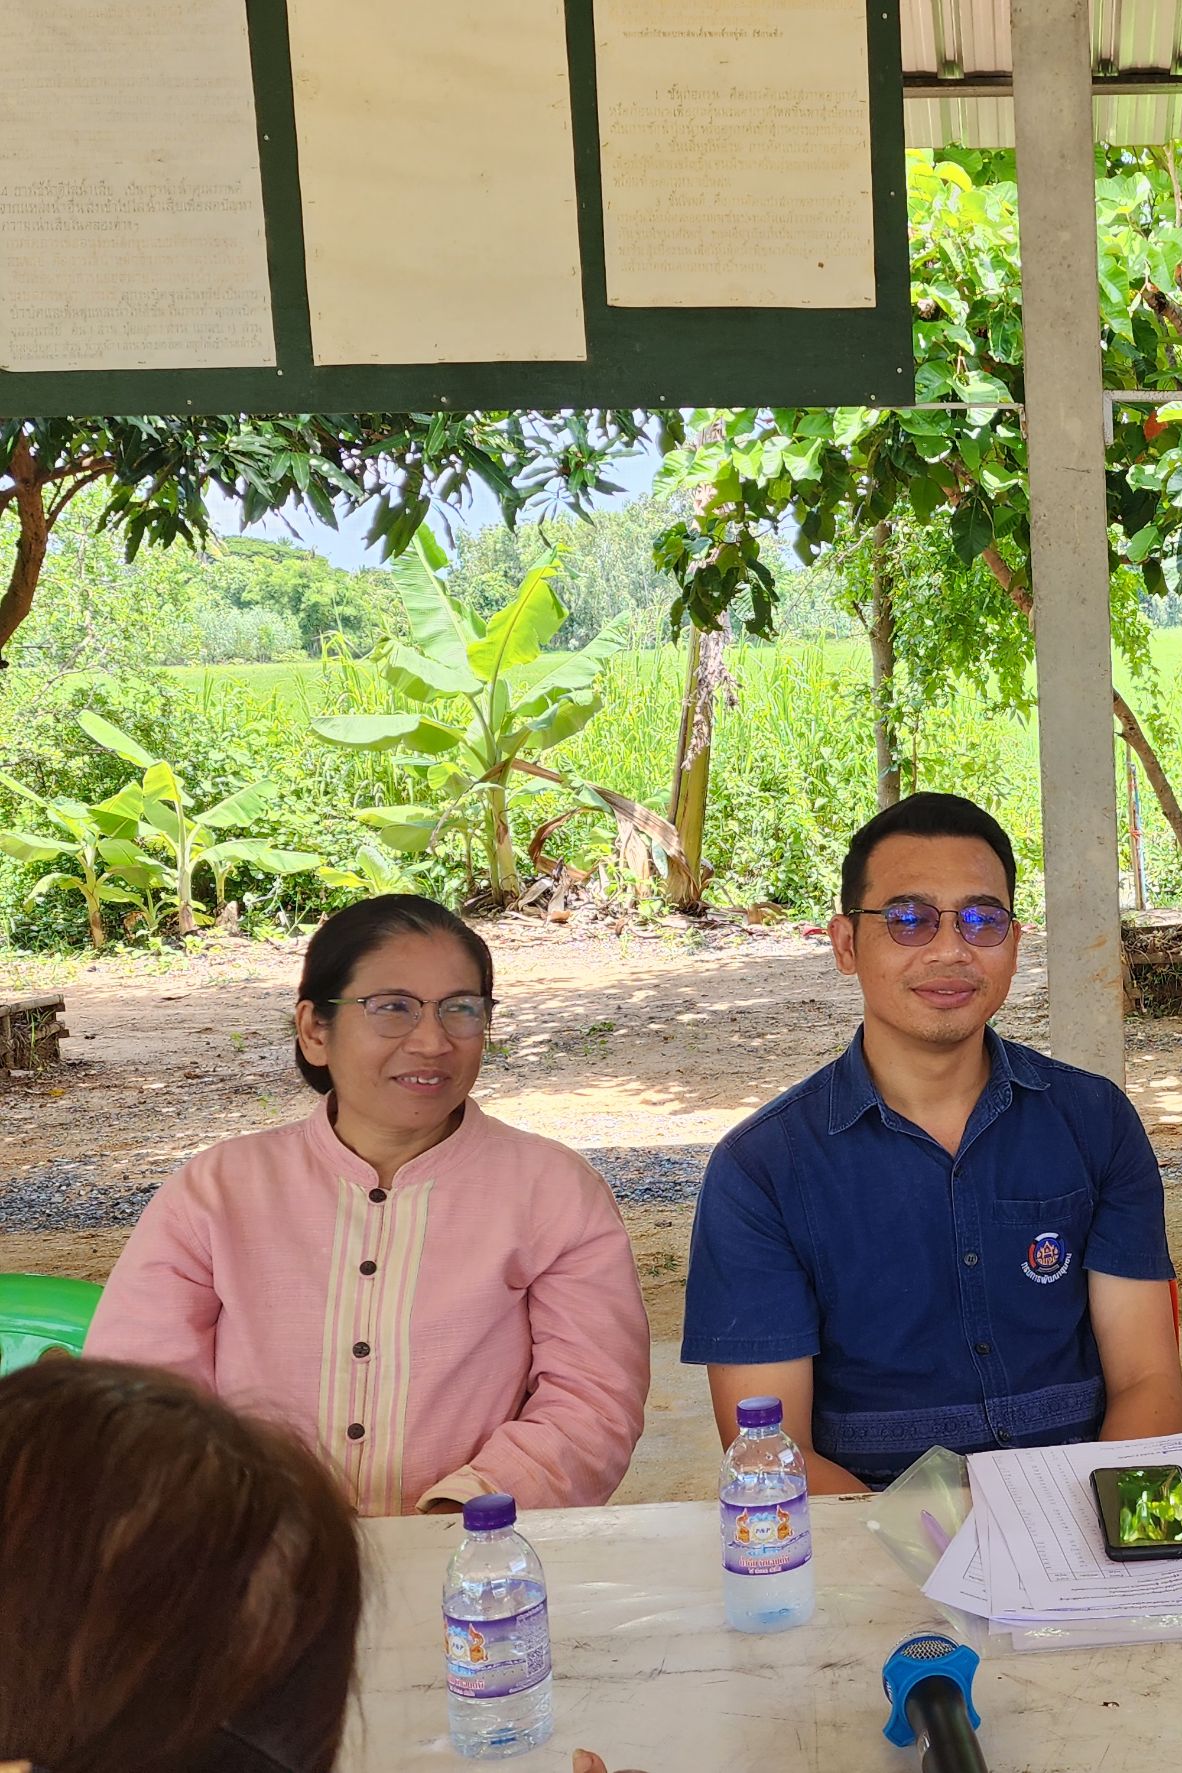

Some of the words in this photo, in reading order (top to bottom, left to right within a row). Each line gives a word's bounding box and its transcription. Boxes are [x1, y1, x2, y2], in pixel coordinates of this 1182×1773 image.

[1020, 1253, 1072, 1284] กรมการพัฒนาชุมชน
